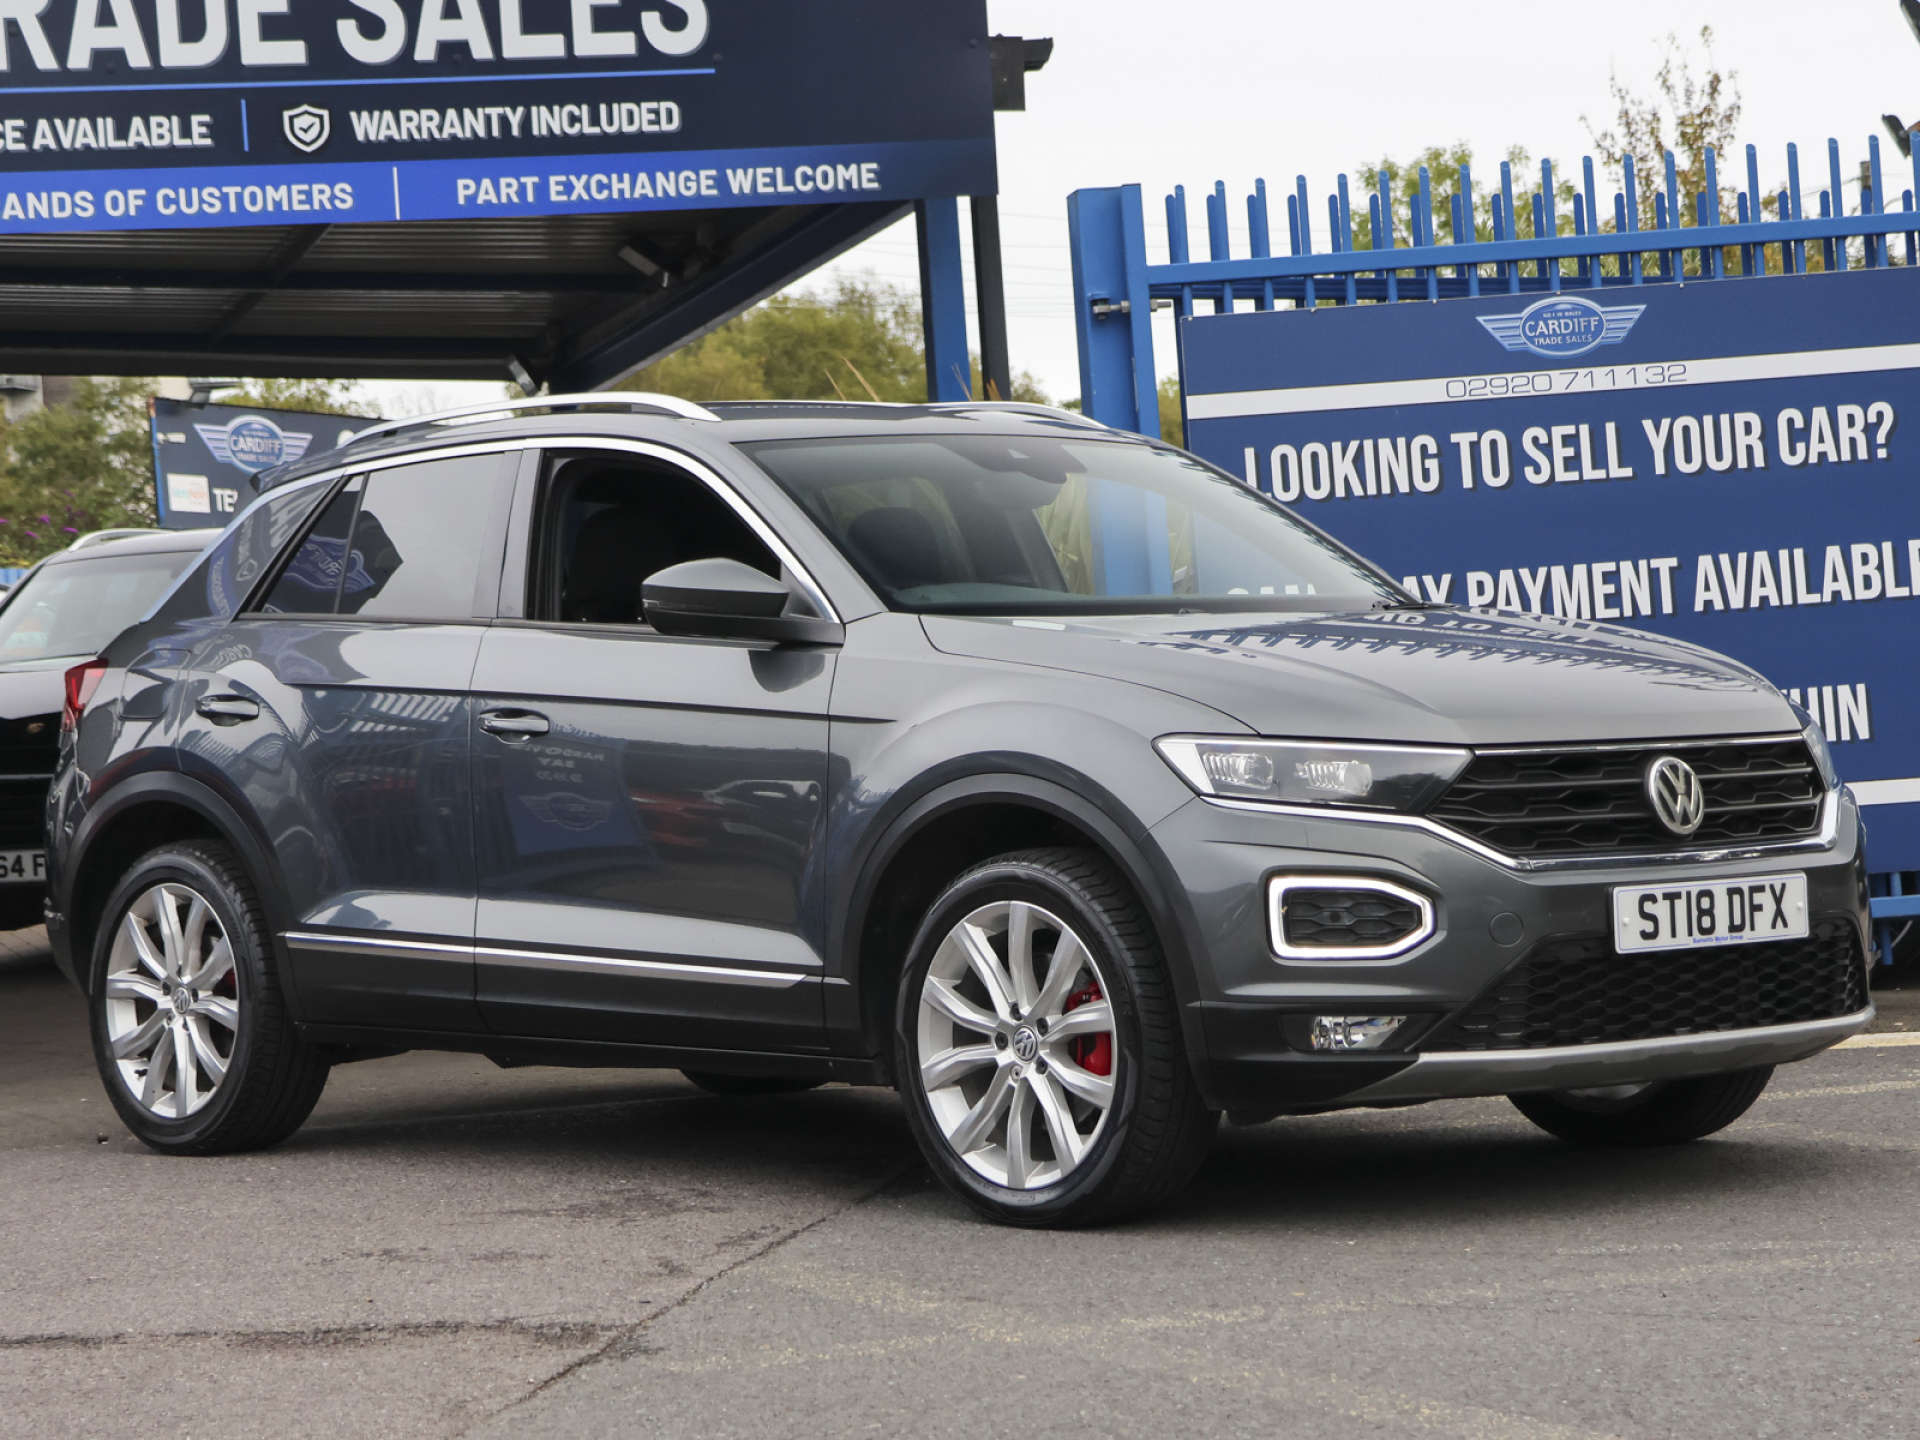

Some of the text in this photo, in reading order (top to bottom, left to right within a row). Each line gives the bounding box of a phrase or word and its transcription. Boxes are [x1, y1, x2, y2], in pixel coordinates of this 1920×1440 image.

[32, 114, 213, 150] AVAILABLE
[350, 101, 681, 142] WARRANTY INCLUDED
[104, 189, 147, 217] OF
[156, 182, 354, 216] CUSTOMERS
[456, 162, 880, 205] PART EXCHANGE WELCOME
[1525, 316, 1600, 337] CARDIFF
[1534, 334, 1593, 346] TRADE SALES
[1445, 364, 1688, 398] 02920 711132
[1244, 401, 1895, 502] LOOKING TO SELL YOUR CAR?
[1466, 557, 1679, 620] PAYMENT
[1637, 883, 1789, 941] ST18 DFX
